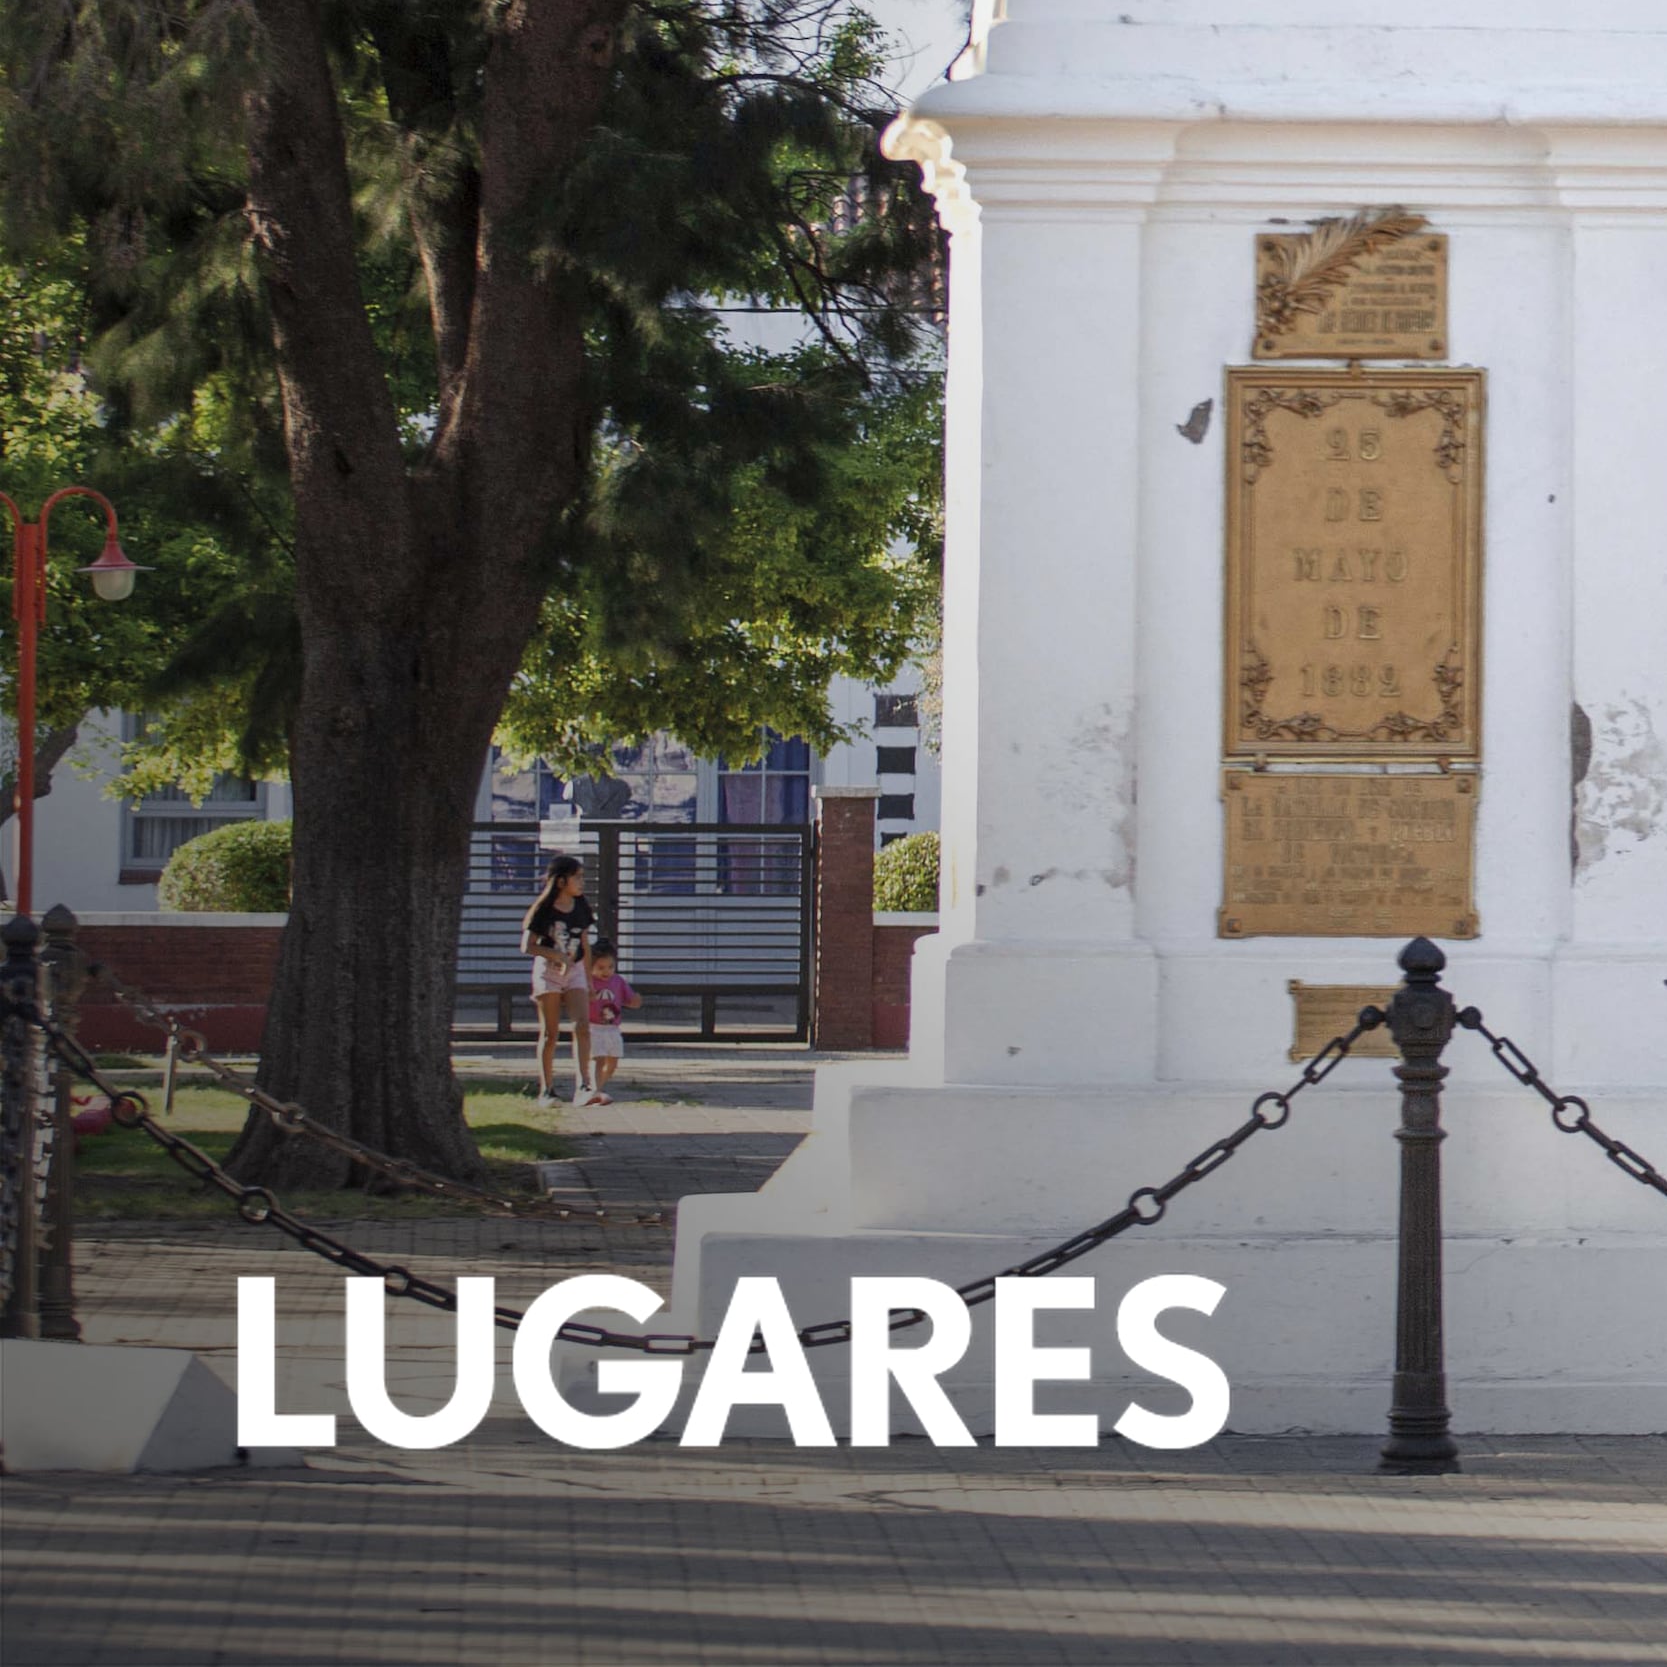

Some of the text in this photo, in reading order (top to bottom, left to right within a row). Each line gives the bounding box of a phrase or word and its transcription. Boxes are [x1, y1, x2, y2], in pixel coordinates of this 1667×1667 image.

[1325, 429, 1381, 462] 25
[1324, 487, 1383, 522] DE
[1293, 548, 1408, 583] MAYO
[1324, 605, 1382, 640] DE
[1299, 663, 1401, 698] 1882
